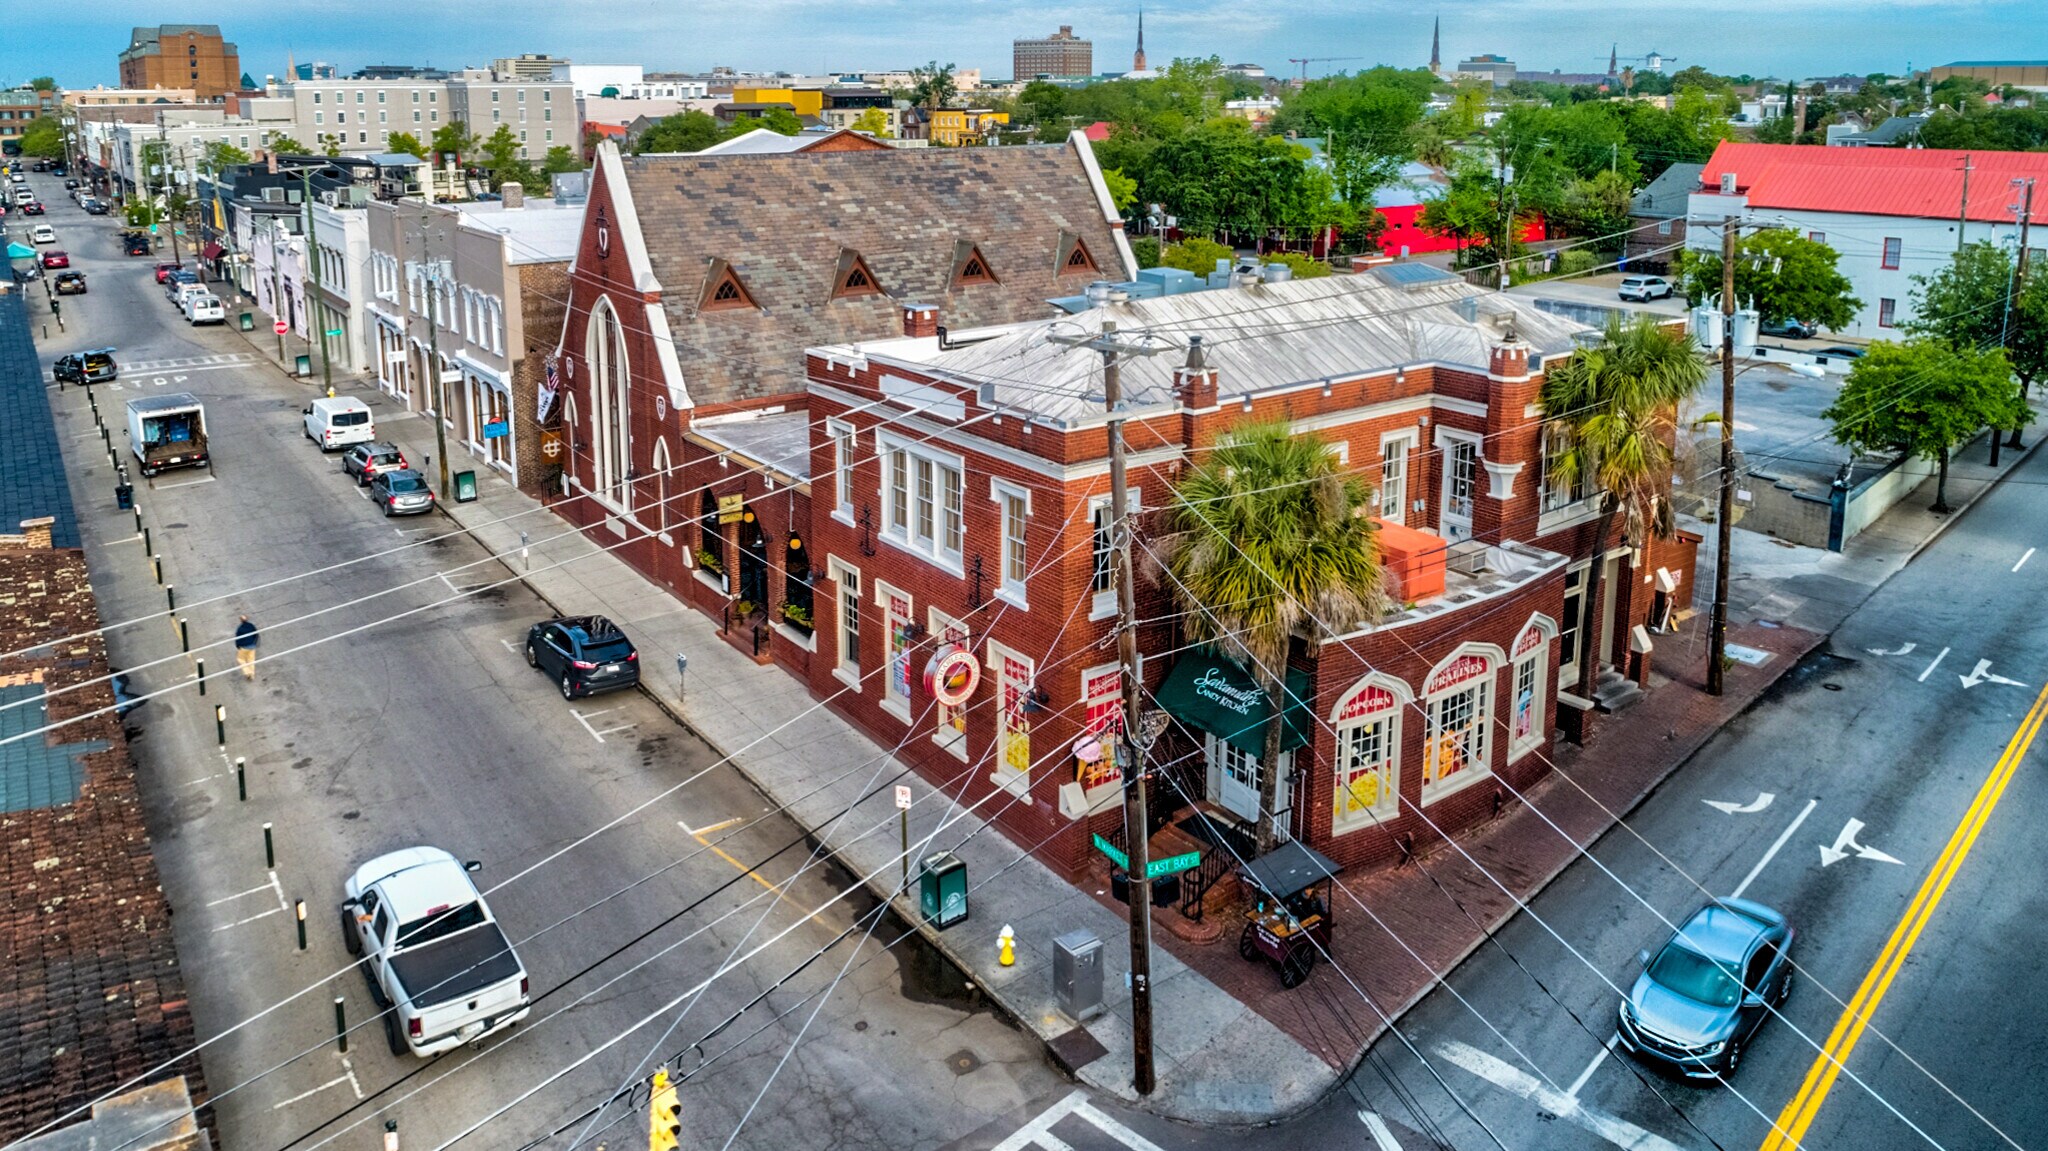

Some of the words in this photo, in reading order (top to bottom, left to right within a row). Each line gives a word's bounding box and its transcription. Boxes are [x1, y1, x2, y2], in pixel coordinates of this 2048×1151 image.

[108, 375, 188, 391] STOP
[1430, 662, 1483, 691] PRALINES
[1196, 685, 1220, 702] CANDY
[1219, 695, 1250, 715] KITCHEN
[1341, 695, 1391, 716] POPCORN
[1148, 862, 1169, 875] EAST
[1173, 857, 1190, 869] BAY
